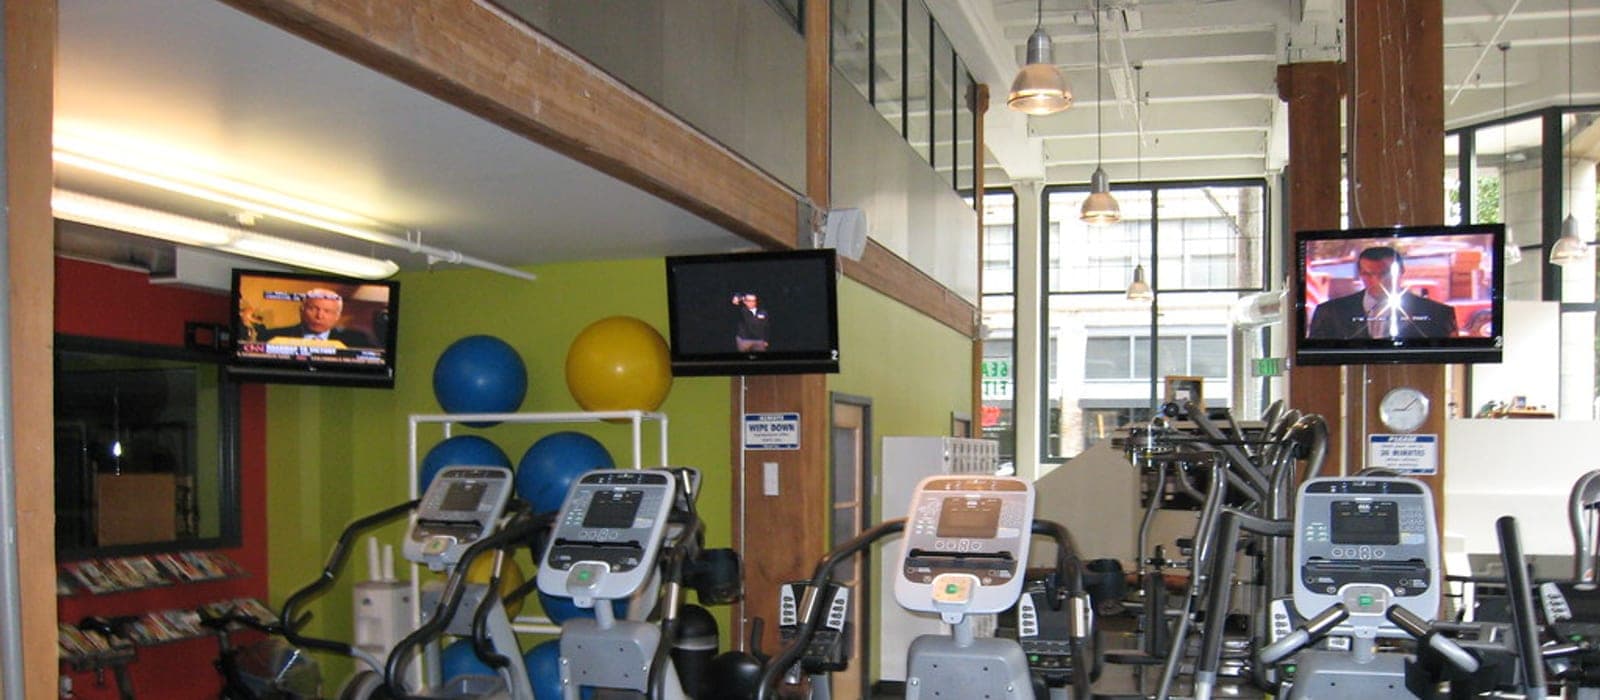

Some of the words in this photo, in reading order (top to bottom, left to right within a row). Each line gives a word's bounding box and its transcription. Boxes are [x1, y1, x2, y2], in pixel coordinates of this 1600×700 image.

[831, 350, 838, 360] 2
[749, 423, 769, 432] WIPE
[770, 423, 795, 432] DOWN
